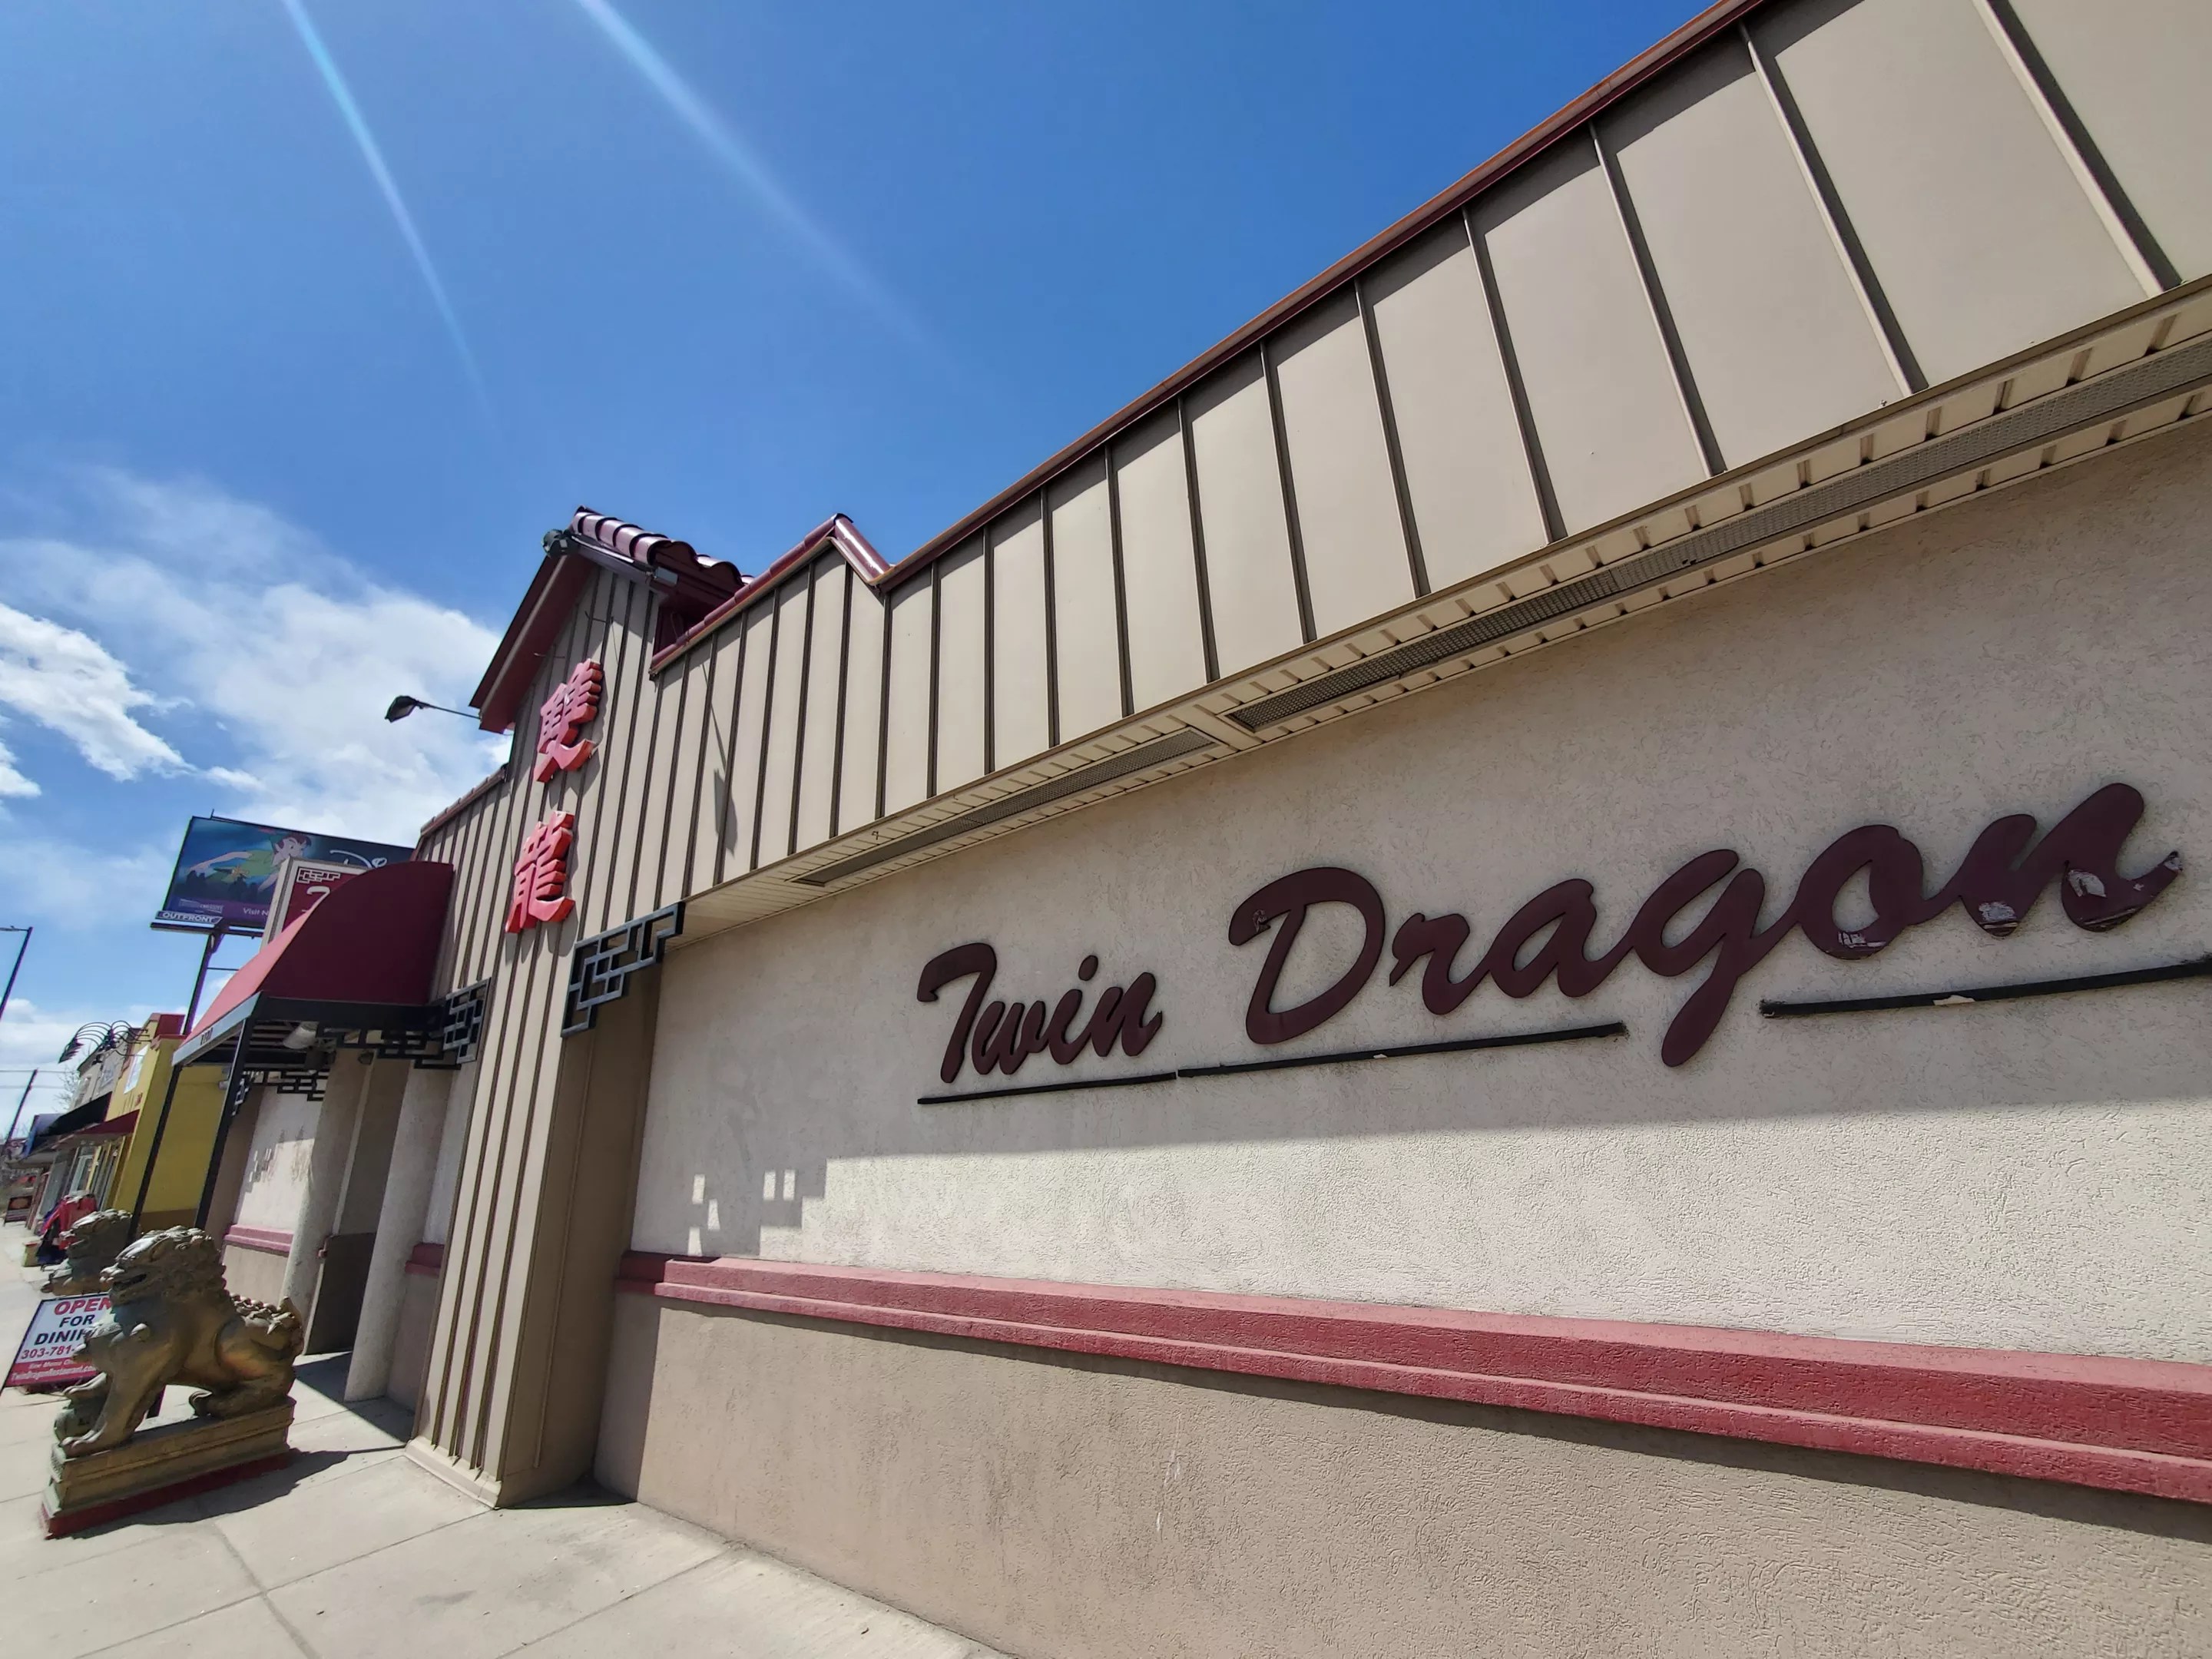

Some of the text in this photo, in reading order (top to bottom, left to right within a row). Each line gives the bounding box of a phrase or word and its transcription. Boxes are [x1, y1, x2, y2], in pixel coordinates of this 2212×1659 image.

[505, 658, 604, 934] 雙龍
[162, 912, 214, 923] OUTFRONT
[917, 782, 2184, 1084] Twin Dragon
[59, 1314, 95, 1328] FOR
[22, 1345, 75, 1359] 303-781-
